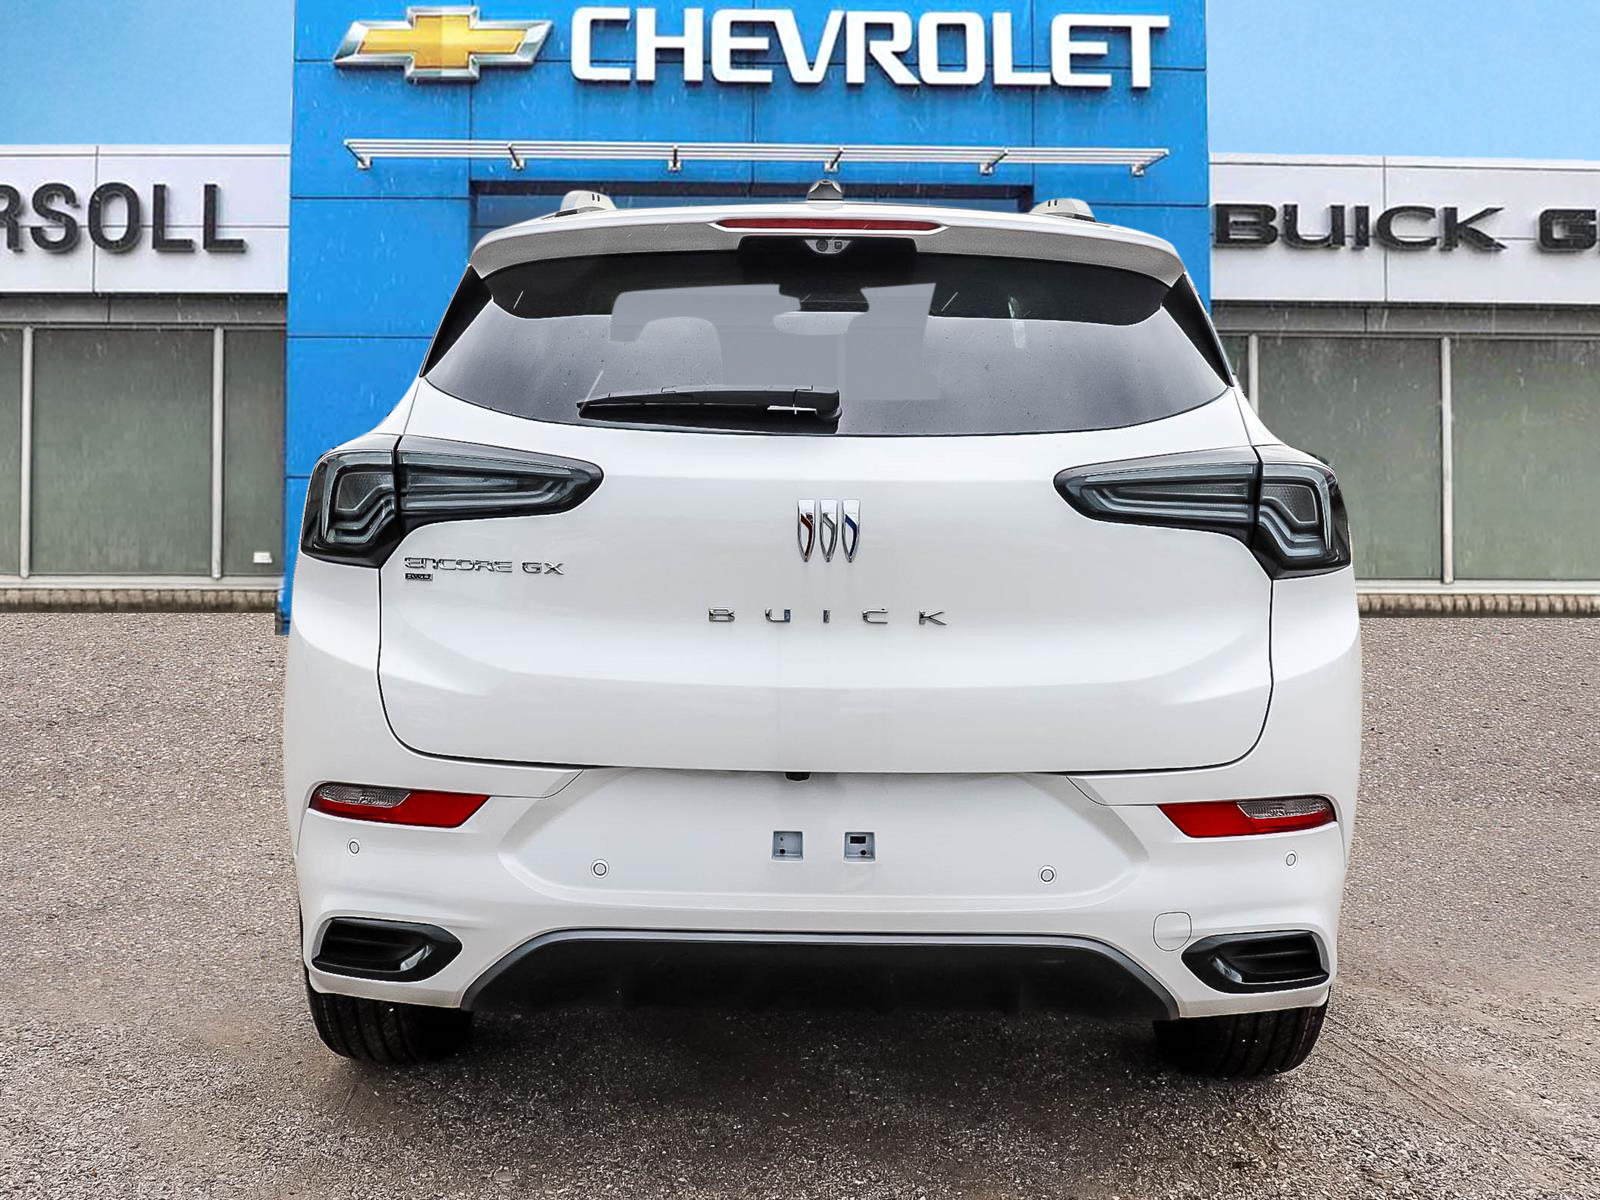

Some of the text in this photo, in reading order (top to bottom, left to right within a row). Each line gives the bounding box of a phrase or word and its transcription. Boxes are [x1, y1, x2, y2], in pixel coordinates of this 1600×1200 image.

[570, 6, 1170, 90] CHEVROLET
[1214, 203, 1600, 253] BUICK G
[521, 562, 564, 576] GX
[708, 608, 947, 626] BUICK
